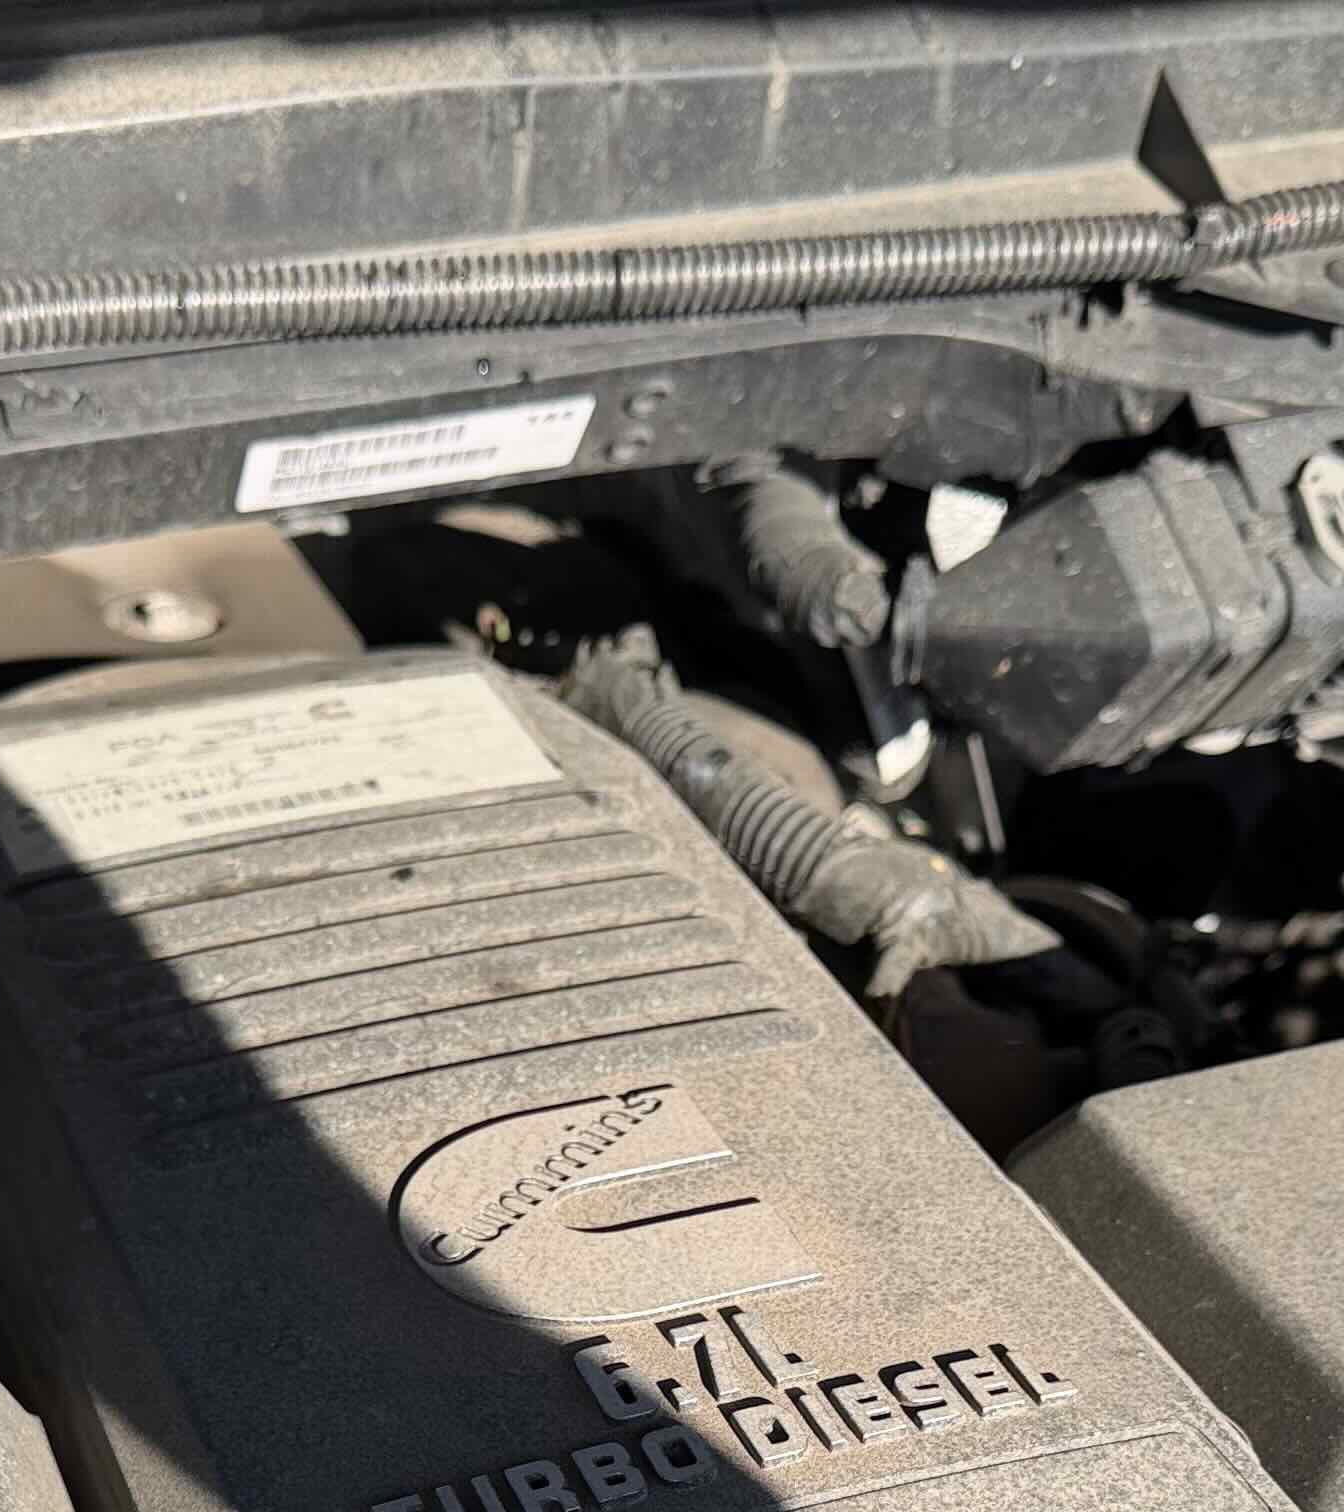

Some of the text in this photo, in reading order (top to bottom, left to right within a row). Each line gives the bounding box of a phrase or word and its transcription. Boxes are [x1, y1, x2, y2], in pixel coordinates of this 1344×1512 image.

[420, 1092, 663, 1267] Cummins
[565, 1306, 820, 1421] 6.7L
[718, 1343, 1078, 1468] DIESEL
